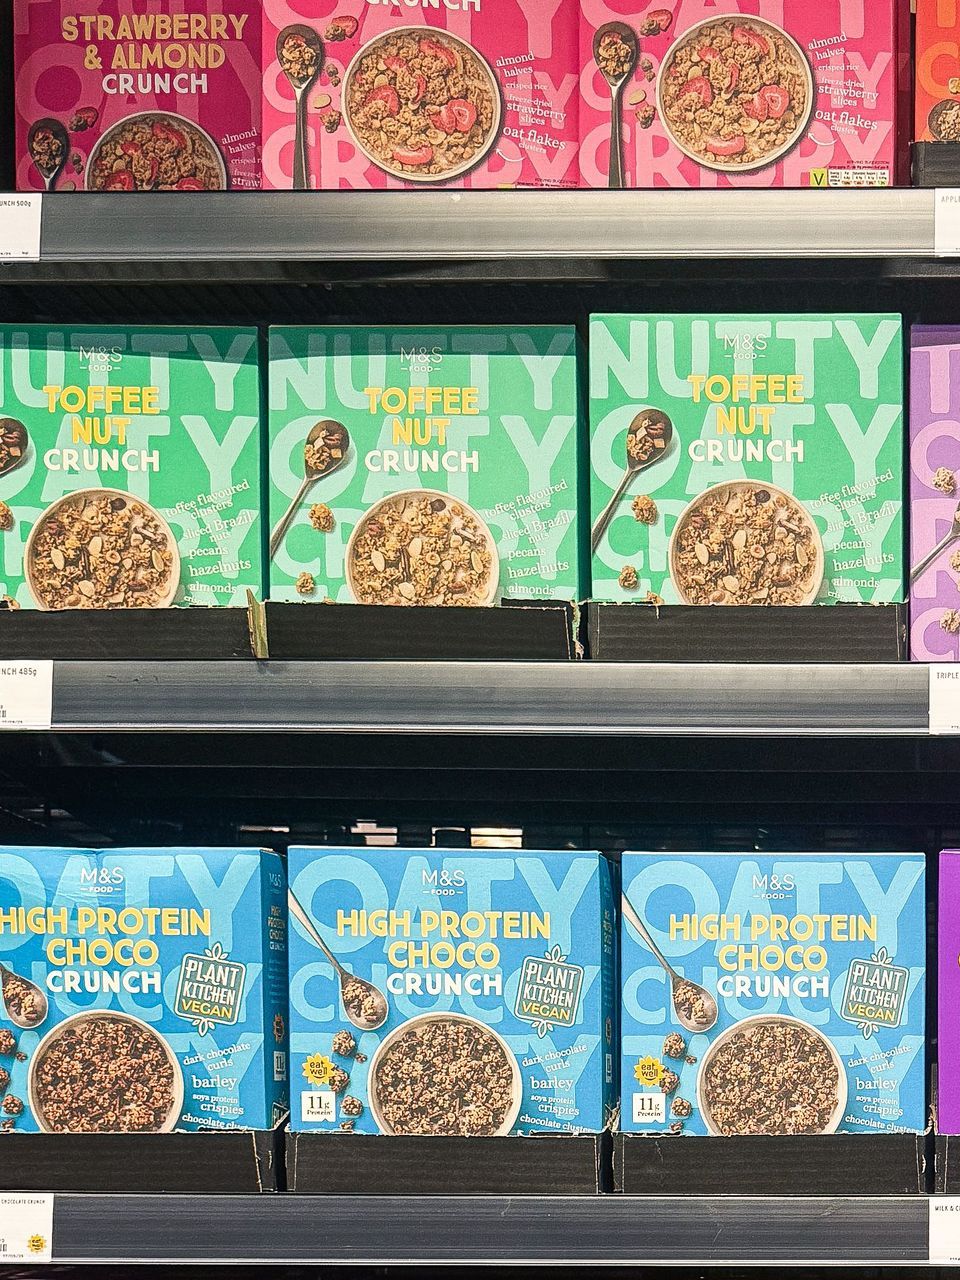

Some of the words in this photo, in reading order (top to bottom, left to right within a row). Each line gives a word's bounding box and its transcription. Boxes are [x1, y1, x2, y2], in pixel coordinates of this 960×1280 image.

[61, 14, 248, 41] STRAWBERRY
[83, 45, 103, 69] &
[111, 44, 225, 69] ALMOND
[496, 52, 535, 69] almond
[102, 73, 208, 94] CRUNCH
[504, 127, 525, 140] oat
[528, 129, 566, 150] flakes
[723, 333, 768, 352] M&S
[687, 374, 805, 403] TOFFEE
[364, 387, 480, 415] TOFFEE
[392, 418, 452, 445] NUT
[716, 407, 775, 435] NUT
[364, 450, 480, 473] CRUNCH
[688, 439, 804, 463] CRUNCH
[508, 559, 569, 578] hazelnuts
[937, 672, 959, 680] TRIPLE
[0, 907, 68, 935] HIGH
[77, 907, 212, 936] PROTEIN
[336, 909, 410, 938] HIGH
[419, 910, 552, 939] PROTEIN
[669, 914, 742, 942] HIGH
[750, 914, 878, 942] PROTEIN
[46, 938, 159, 966] CHOCO
[387, 942, 500, 969] CHOCO
[718, 946, 828, 972] CHOCO
[46, 971, 162, 995] CRUNCH
[387, 973, 502, 996] CRUNCH
[525, 962, 577, 991] PLANT
[717, 976, 829, 998] CRUNCH
[522, 983, 575, 1008] KITCHEN
[521, 1002, 571, 1021] VEGAN
[309, 1066, 328, 1075] well
[530, 1075, 574, 1092] barley
